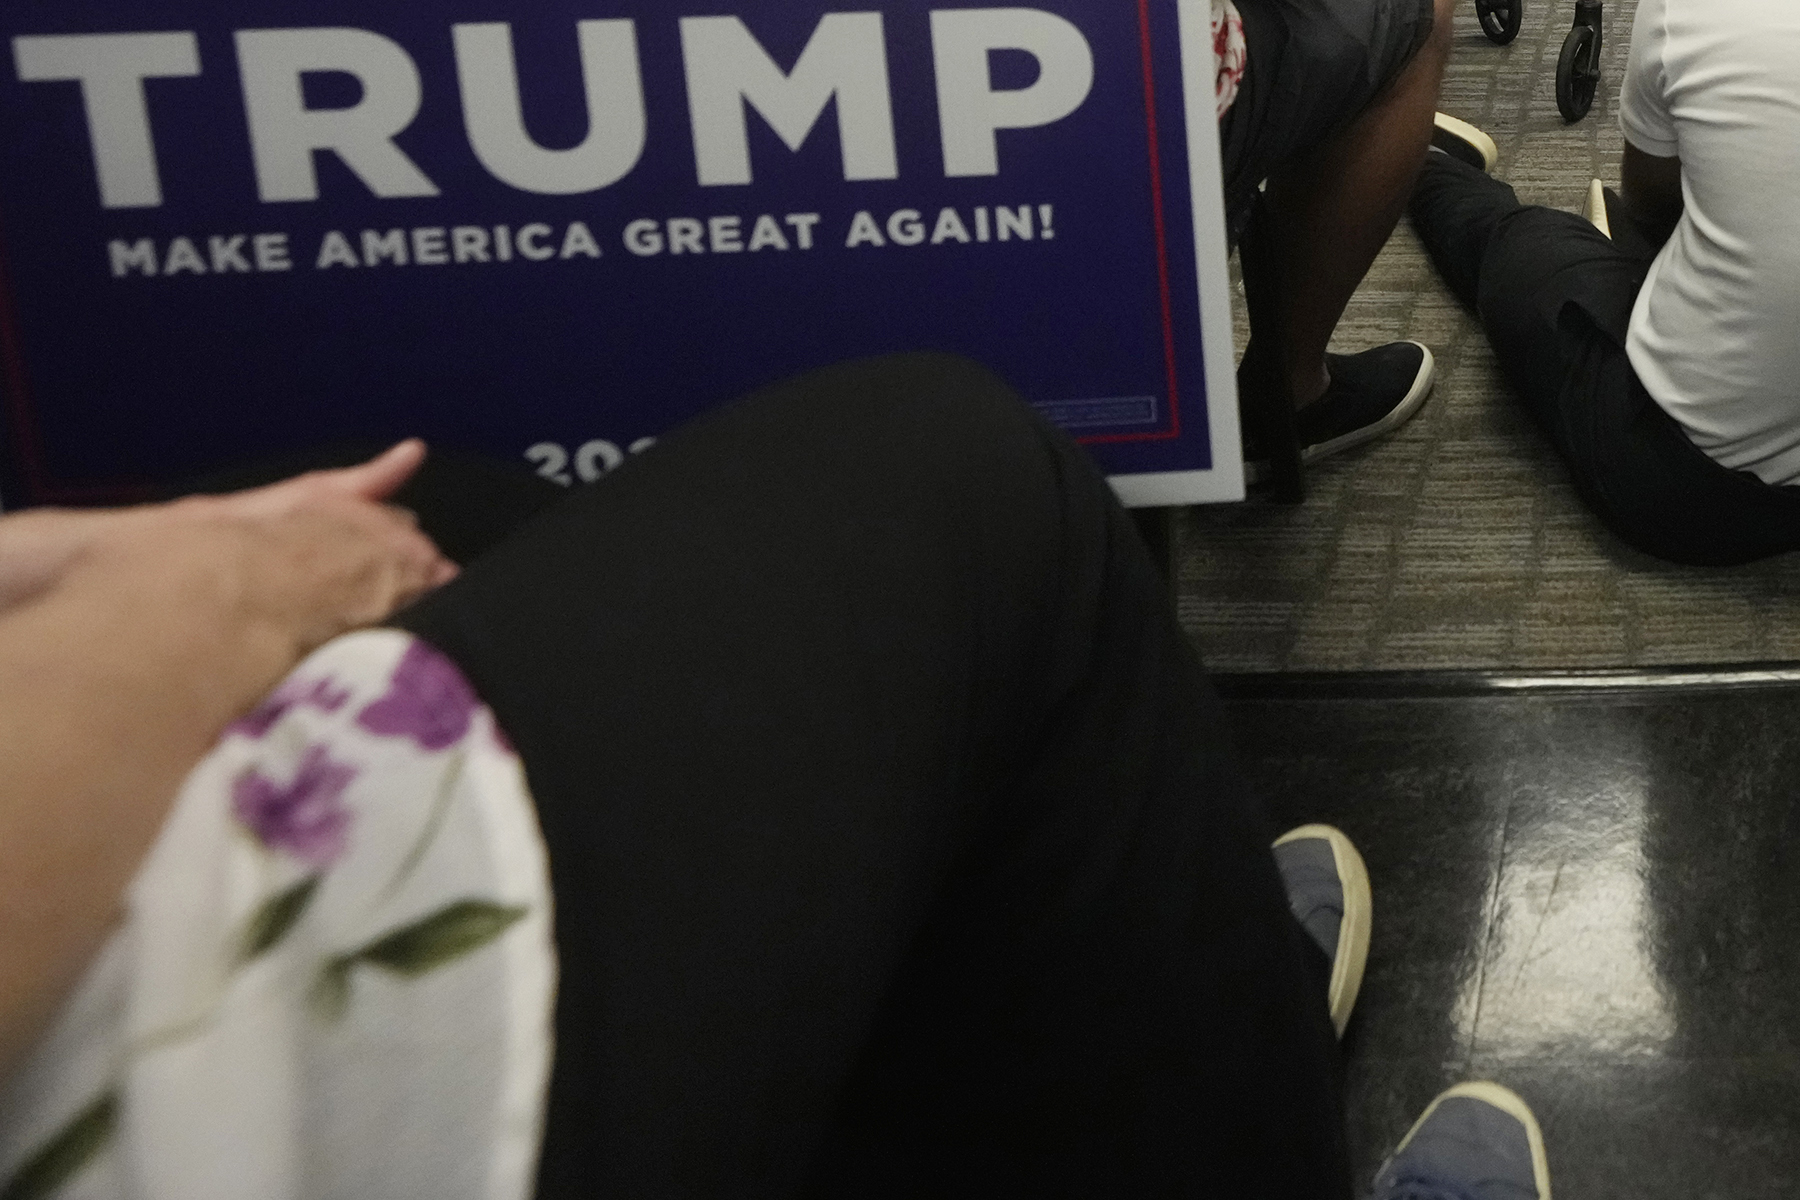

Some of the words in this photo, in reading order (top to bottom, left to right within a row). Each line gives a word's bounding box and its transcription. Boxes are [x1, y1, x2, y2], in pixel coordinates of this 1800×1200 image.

[12, 6, 1094, 208] TRUMP
[108, 233, 292, 277] MAKE
[315, 221, 601, 268] AMERICA
[622, 212, 820, 257] GREAT
[845, 204, 1055, 249] AGAIN!
[522, 435, 658, 490] 20
